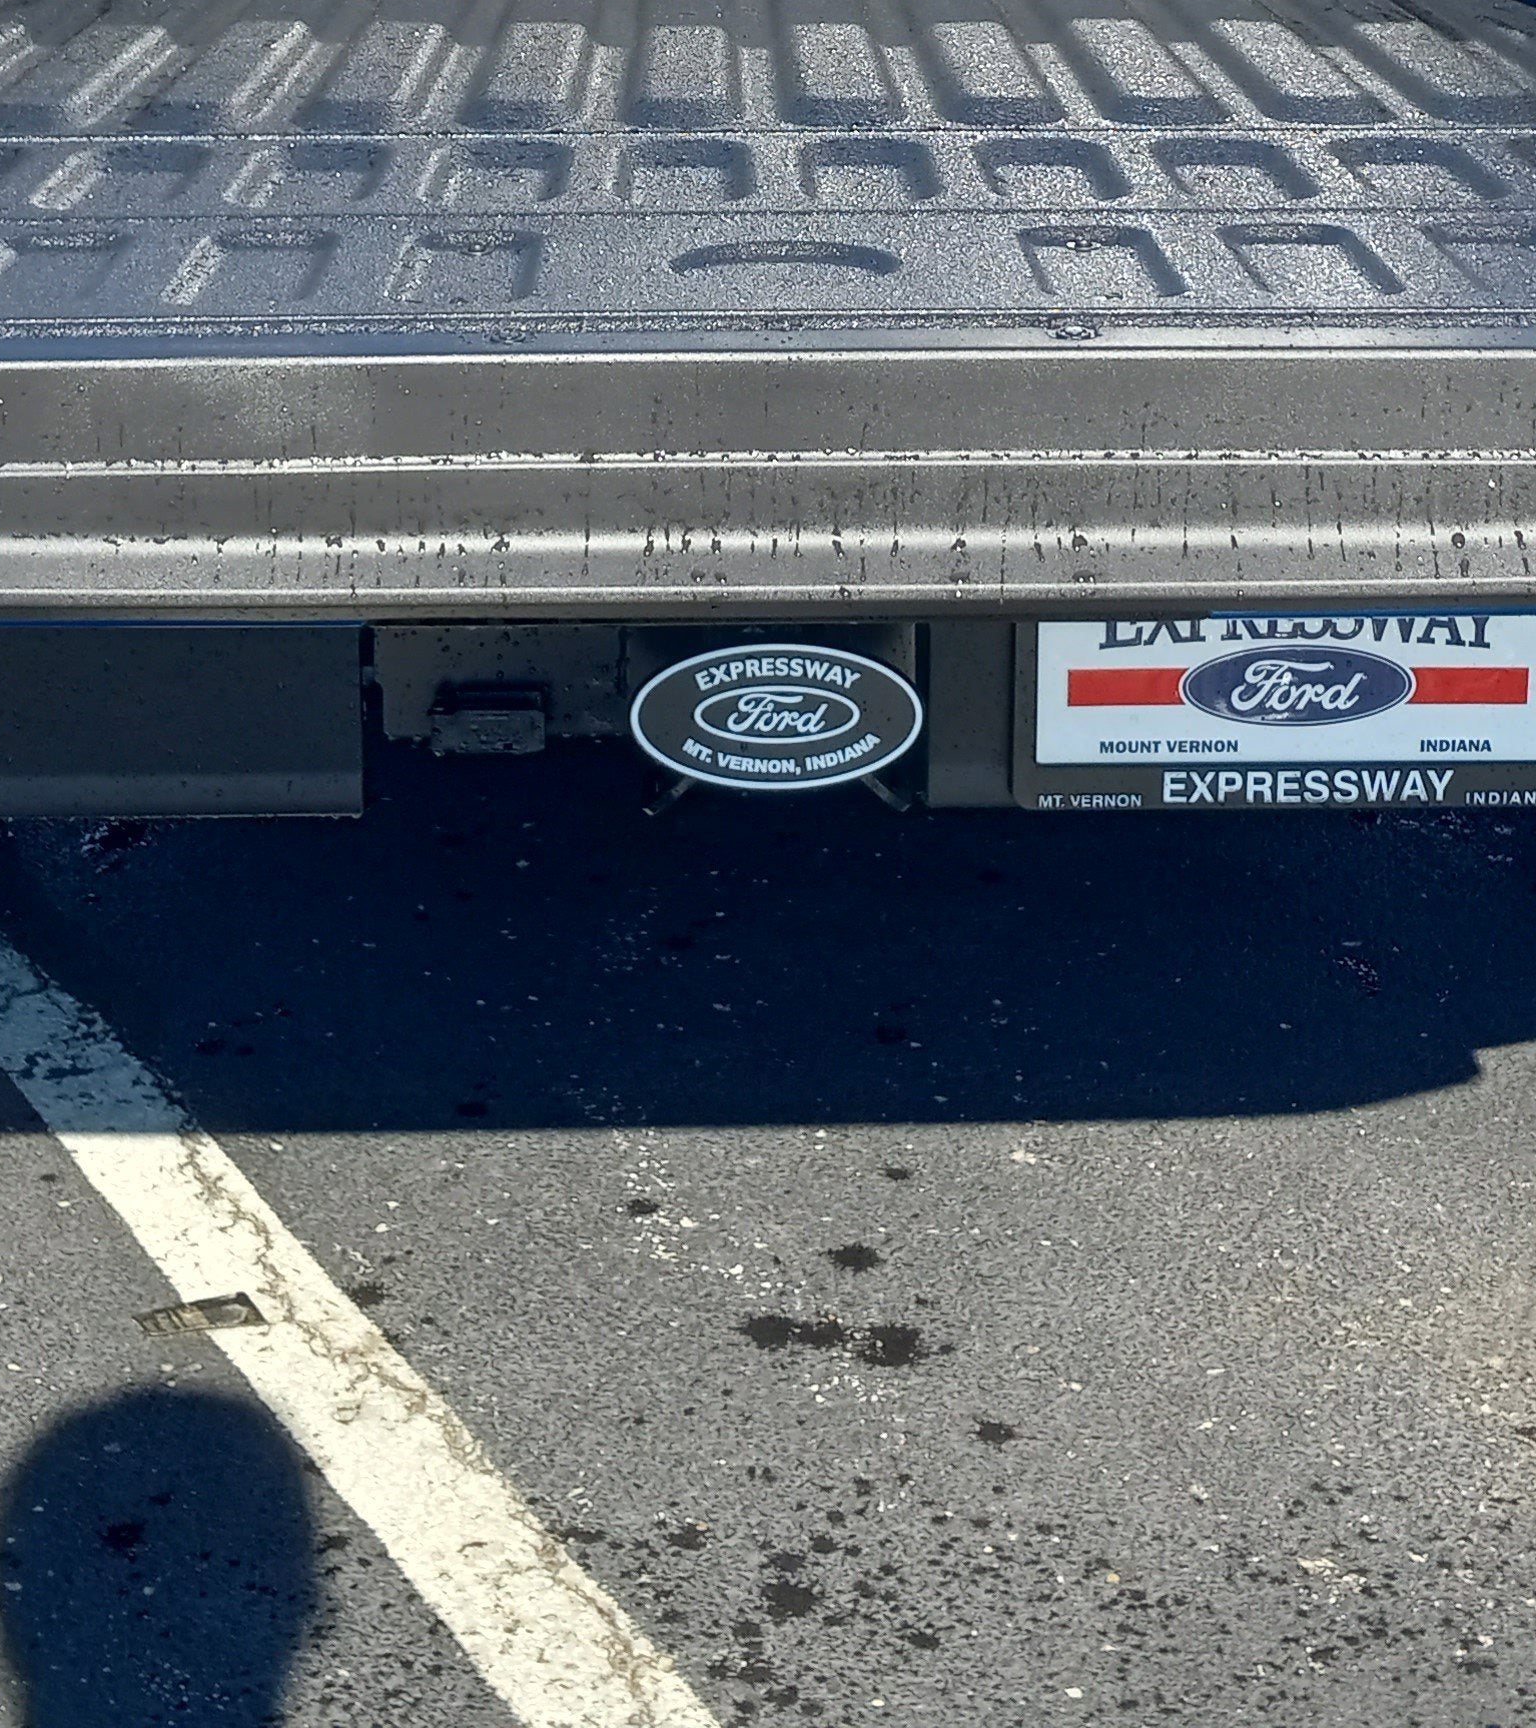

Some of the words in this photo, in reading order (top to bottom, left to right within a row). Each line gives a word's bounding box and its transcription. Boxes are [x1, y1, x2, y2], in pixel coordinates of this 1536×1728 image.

[694, 657, 862, 691] EXPRESSWAY
[1230, 658, 1364, 711] Ford
[727, 692, 829, 733] Ford
[681, 737, 712, 764] MT.
[717, 753, 802, 776] VERNON,
[805, 732, 882, 772] INDIANA
[1099, 740, 1161, 754] MOUNT
[1166, 739, 1239, 753] VERNON
[1420, 739, 1492, 752] INDIANA
[1038, 794, 1064, 808] MT.
[1070, 794, 1142, 808] VERNON
[1163, 769, 1455, 805] EXPRESSWAY
